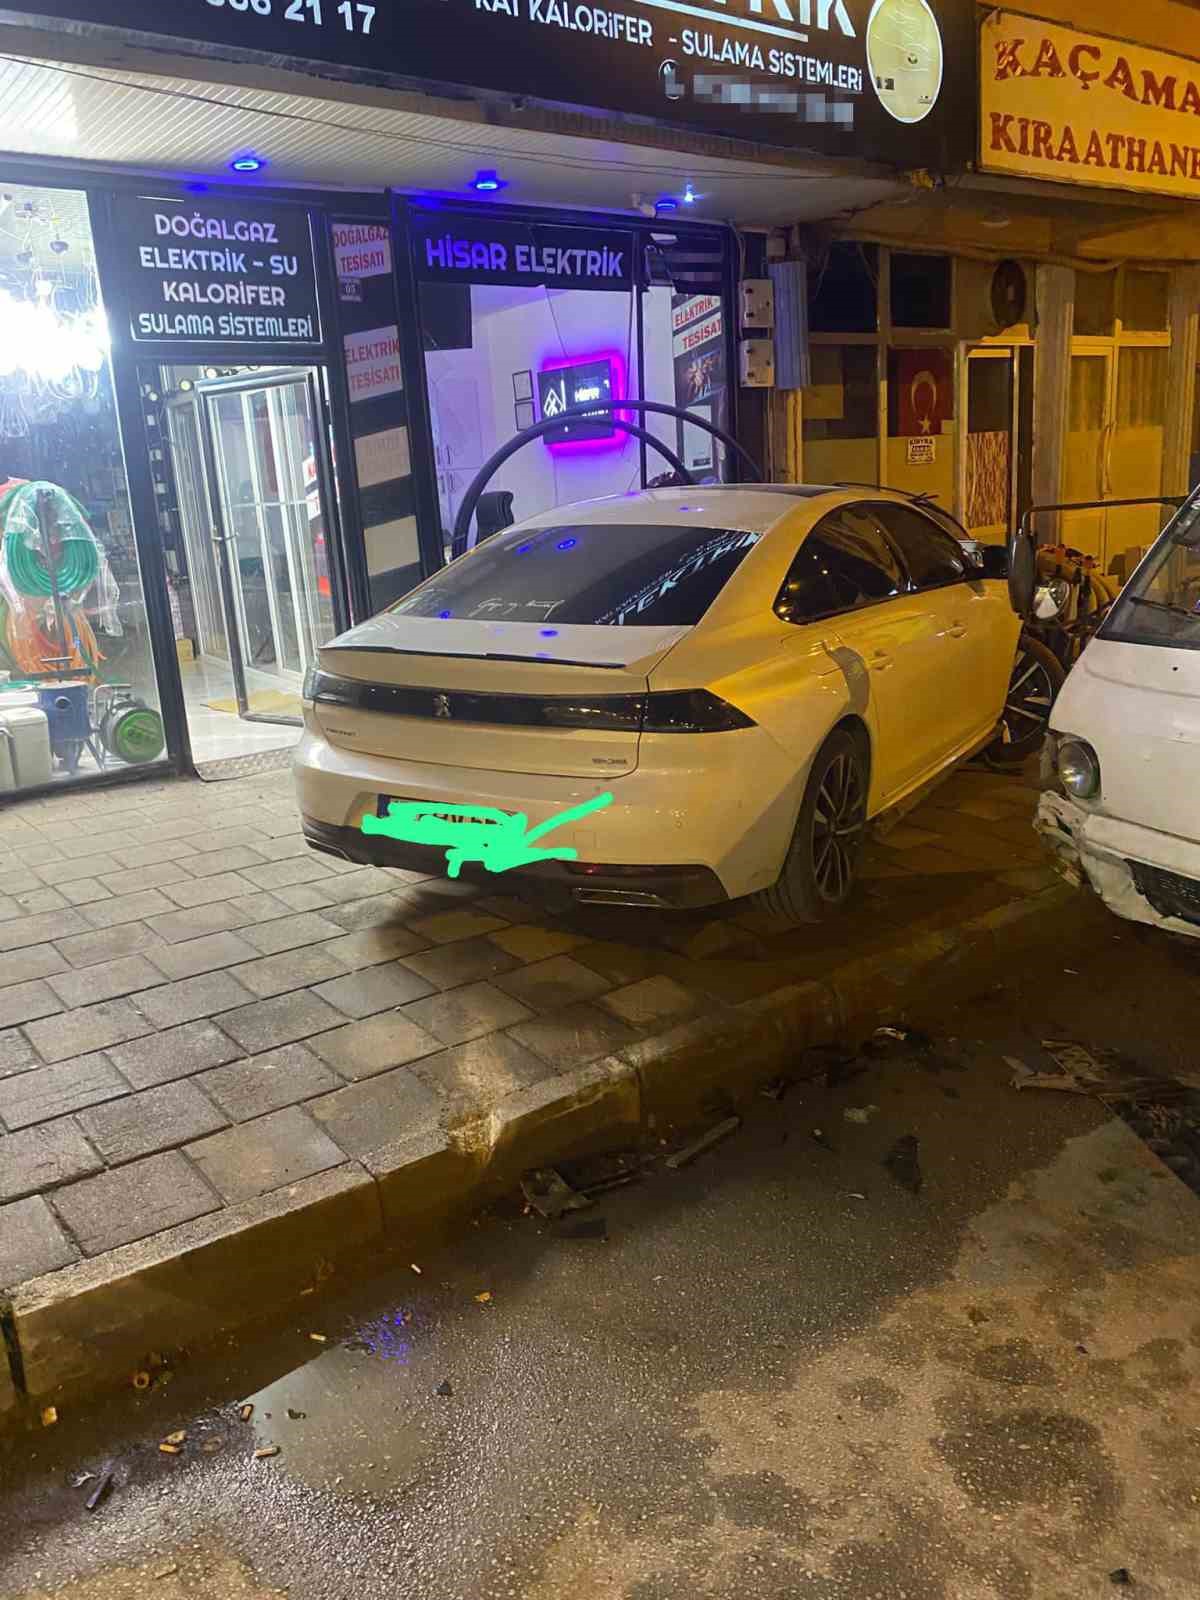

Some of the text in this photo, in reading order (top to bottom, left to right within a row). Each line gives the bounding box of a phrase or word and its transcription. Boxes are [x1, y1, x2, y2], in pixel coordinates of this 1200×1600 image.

[284, 0, 322, 25] 21
[337, 1, 376, 34] 17
[682, 29, 765, 70] SULAMA
[154, 212, 278, 243] DOĞALGAZ
[139, 246, 248, 273] ELEKTRİK
[269, 255, 298, 275] SU
[425, 234, 624, 277] HİSAR ELEKTRİK
[162, 280, 285, 306] KALORİFER
[138, 311, 313, 337] SULAMA SİSTEMLERİ
